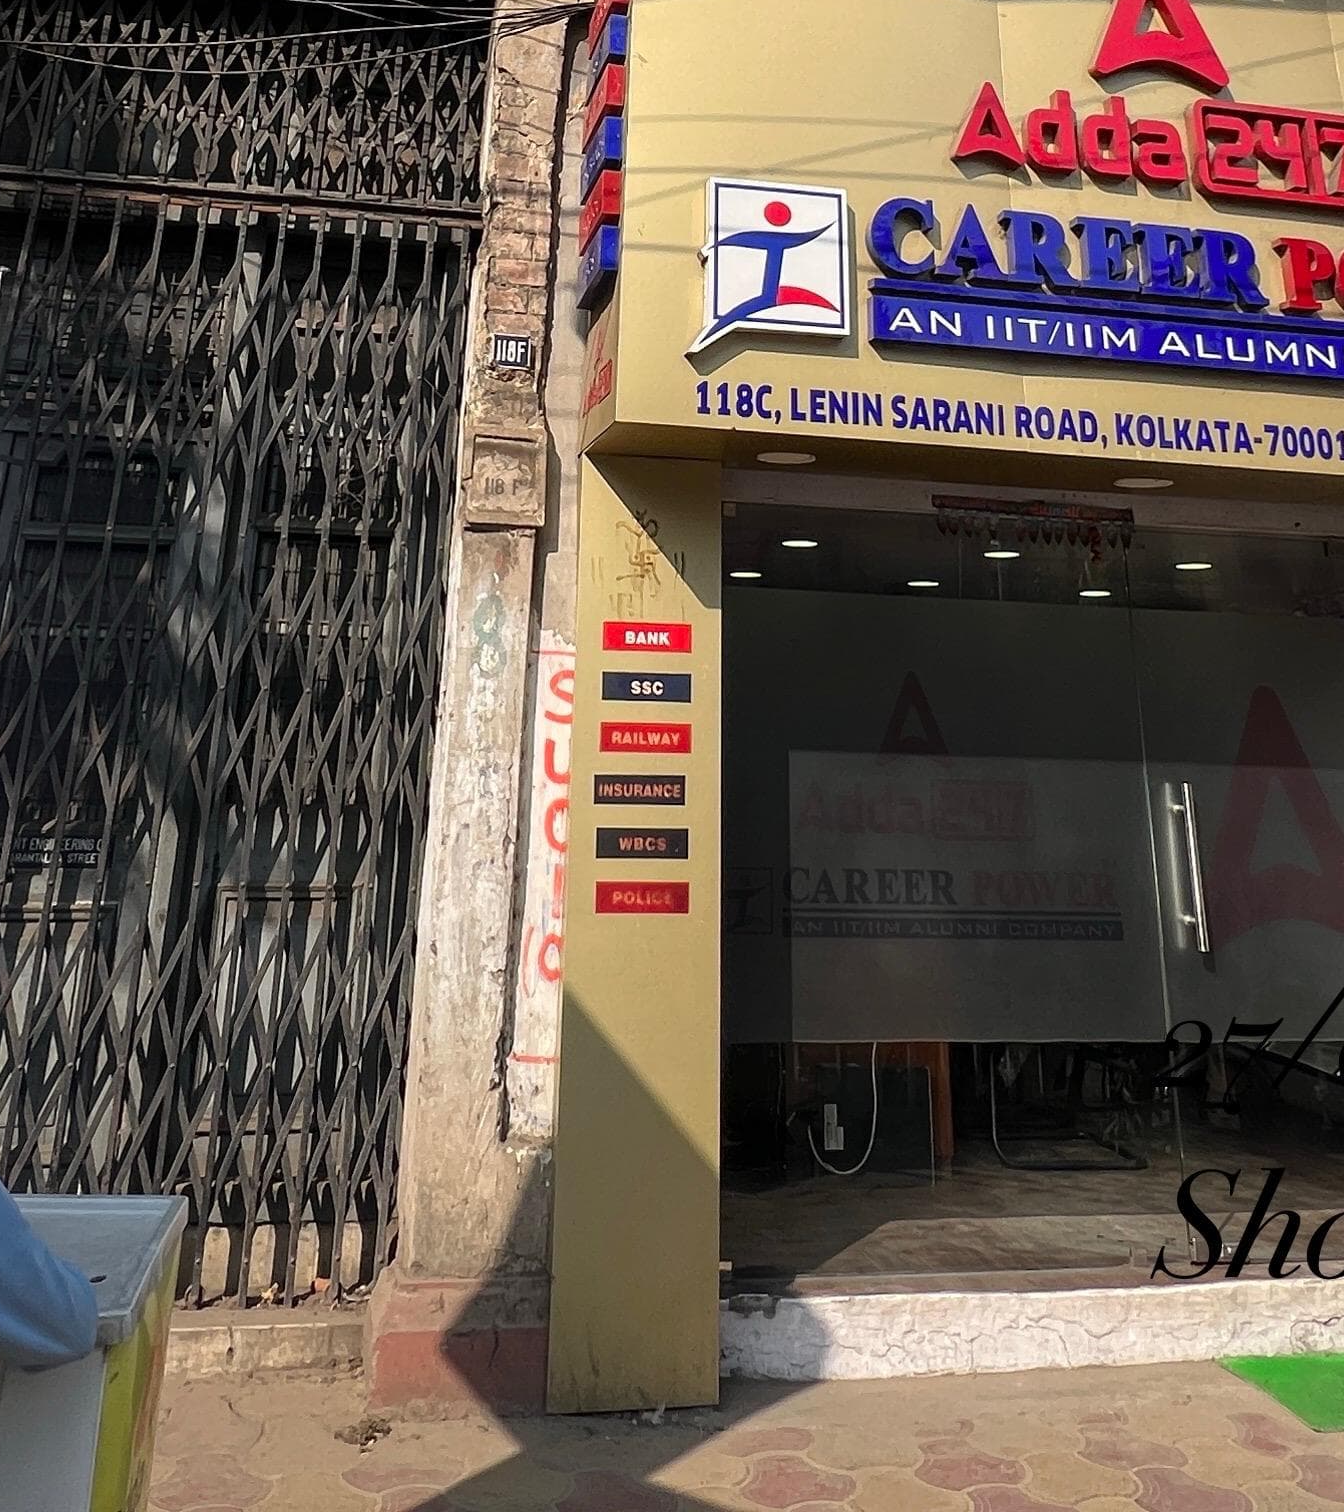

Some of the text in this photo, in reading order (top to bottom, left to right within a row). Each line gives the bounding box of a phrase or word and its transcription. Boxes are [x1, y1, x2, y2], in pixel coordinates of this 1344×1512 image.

[865, 195, 1271, 309] CAREER
[888, 306, 962, 338] AN
[985, 314, 1138, 353] IIT/IIM
[497, 339, 528, 363] 118F
[696, 380, 782, 425] 118C,
[790, 387, 883, 427] LENIN
[891, 393, 1005, 437] SARANI
[1015, 405, 1109, 450] ROAD,
[625, 631, 670, 647] BANK
[630, 680, 665, 696] SSC
[611, 730, 681, 746] RAILWAY
[598, 783, 681, 799] INSURANCE
[618, 837, 668, 852] WBCS
[783, 867, 958, 906] CAREER
